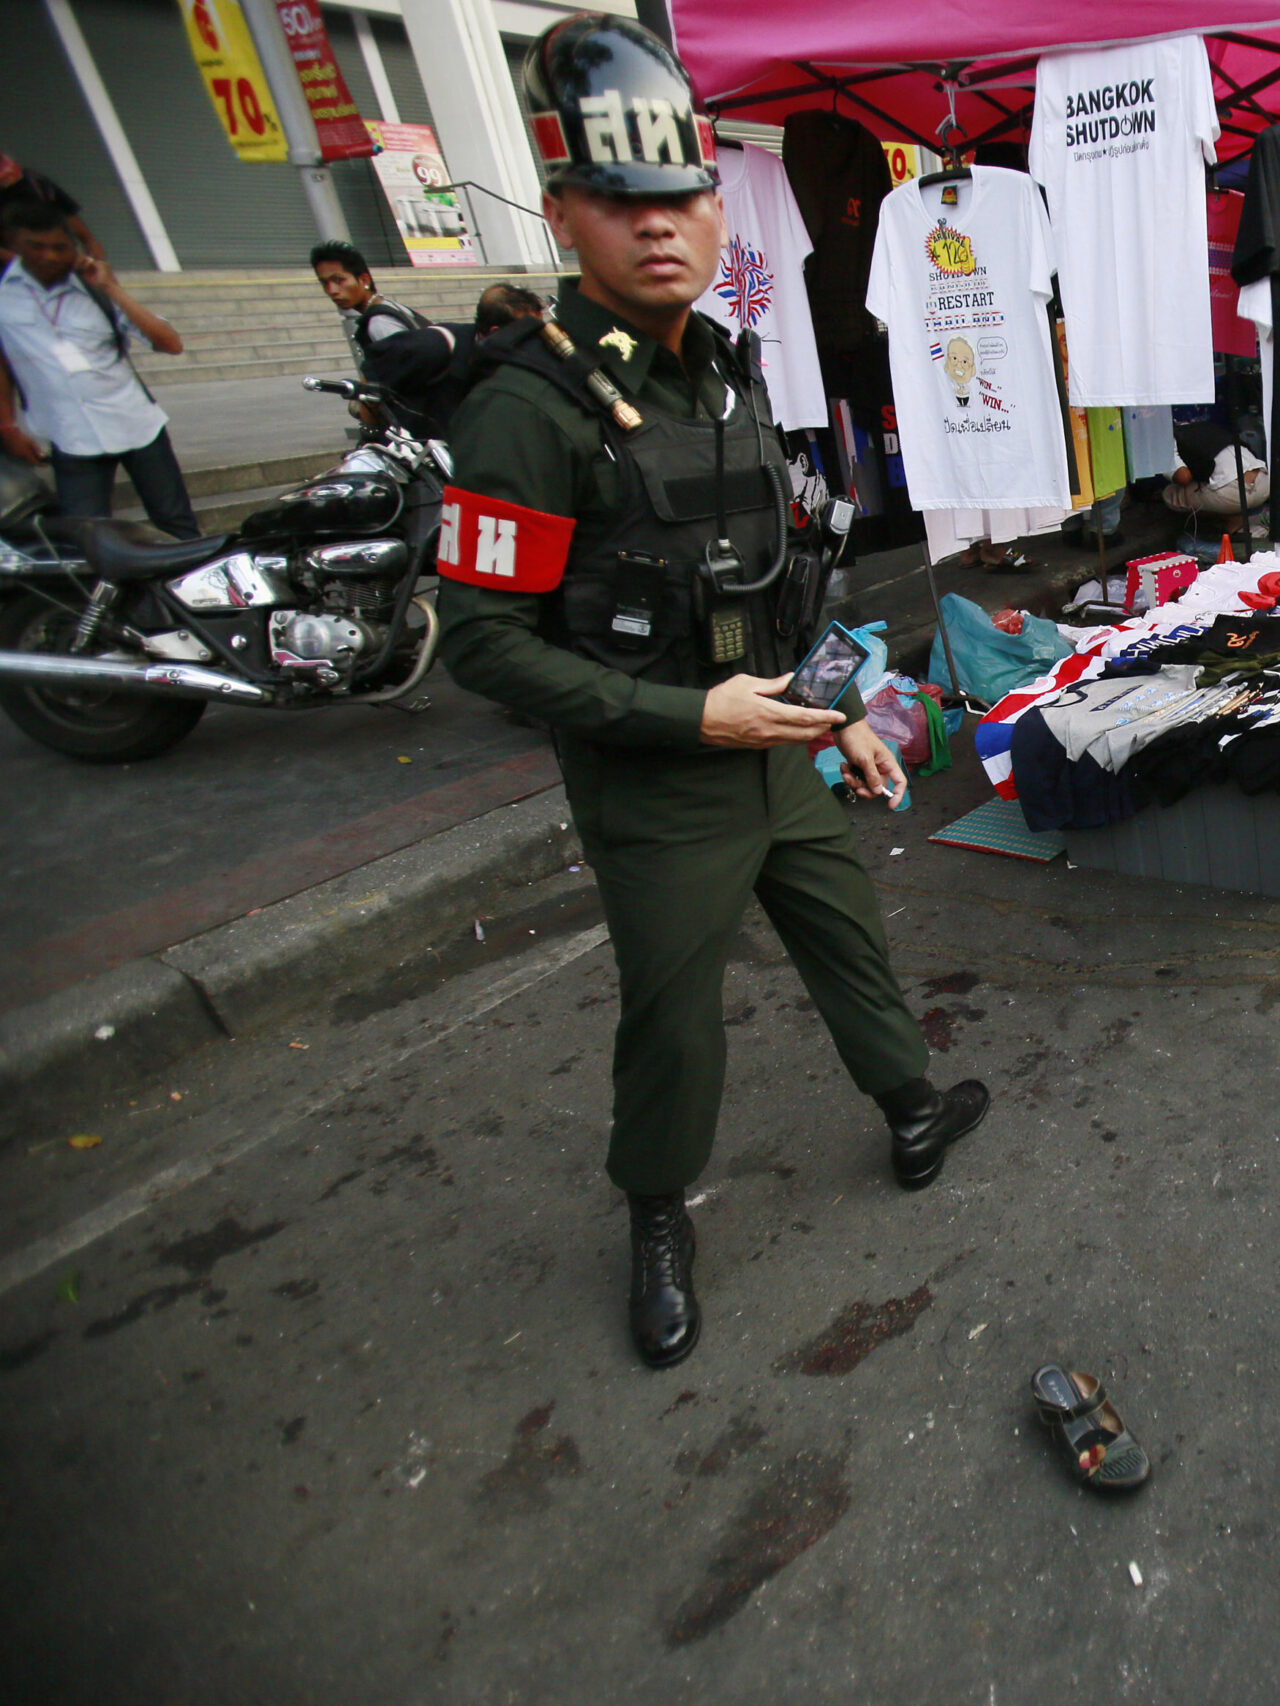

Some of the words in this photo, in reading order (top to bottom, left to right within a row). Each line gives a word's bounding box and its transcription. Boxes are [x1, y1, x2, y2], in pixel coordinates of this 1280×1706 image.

[1066, 78, 1155, 119] BANGKOK
[1066, 109, 1156, 147] SHUTDOWN
[937, 291, 995, 311] RESTART
